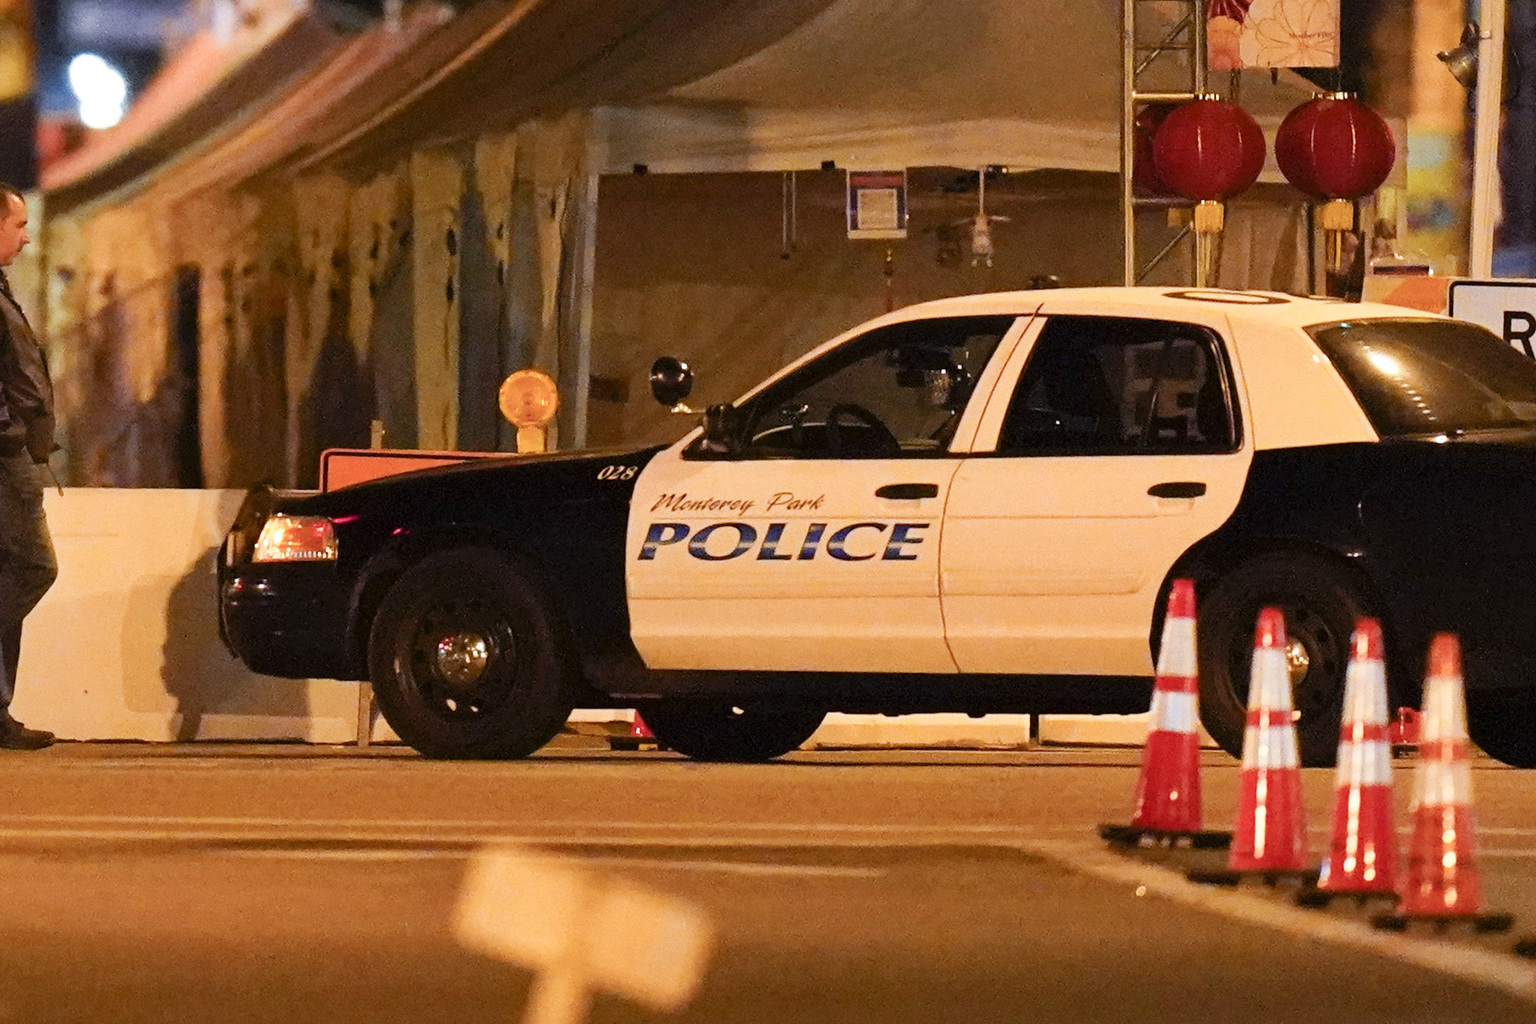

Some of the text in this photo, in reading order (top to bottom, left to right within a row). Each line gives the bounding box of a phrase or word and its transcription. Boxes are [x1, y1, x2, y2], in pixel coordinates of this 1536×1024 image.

[596, 464, 638, 480] 028
[650, 492, 826, 516] Monterey Park
[637, 521, 931, 562] POLICE
